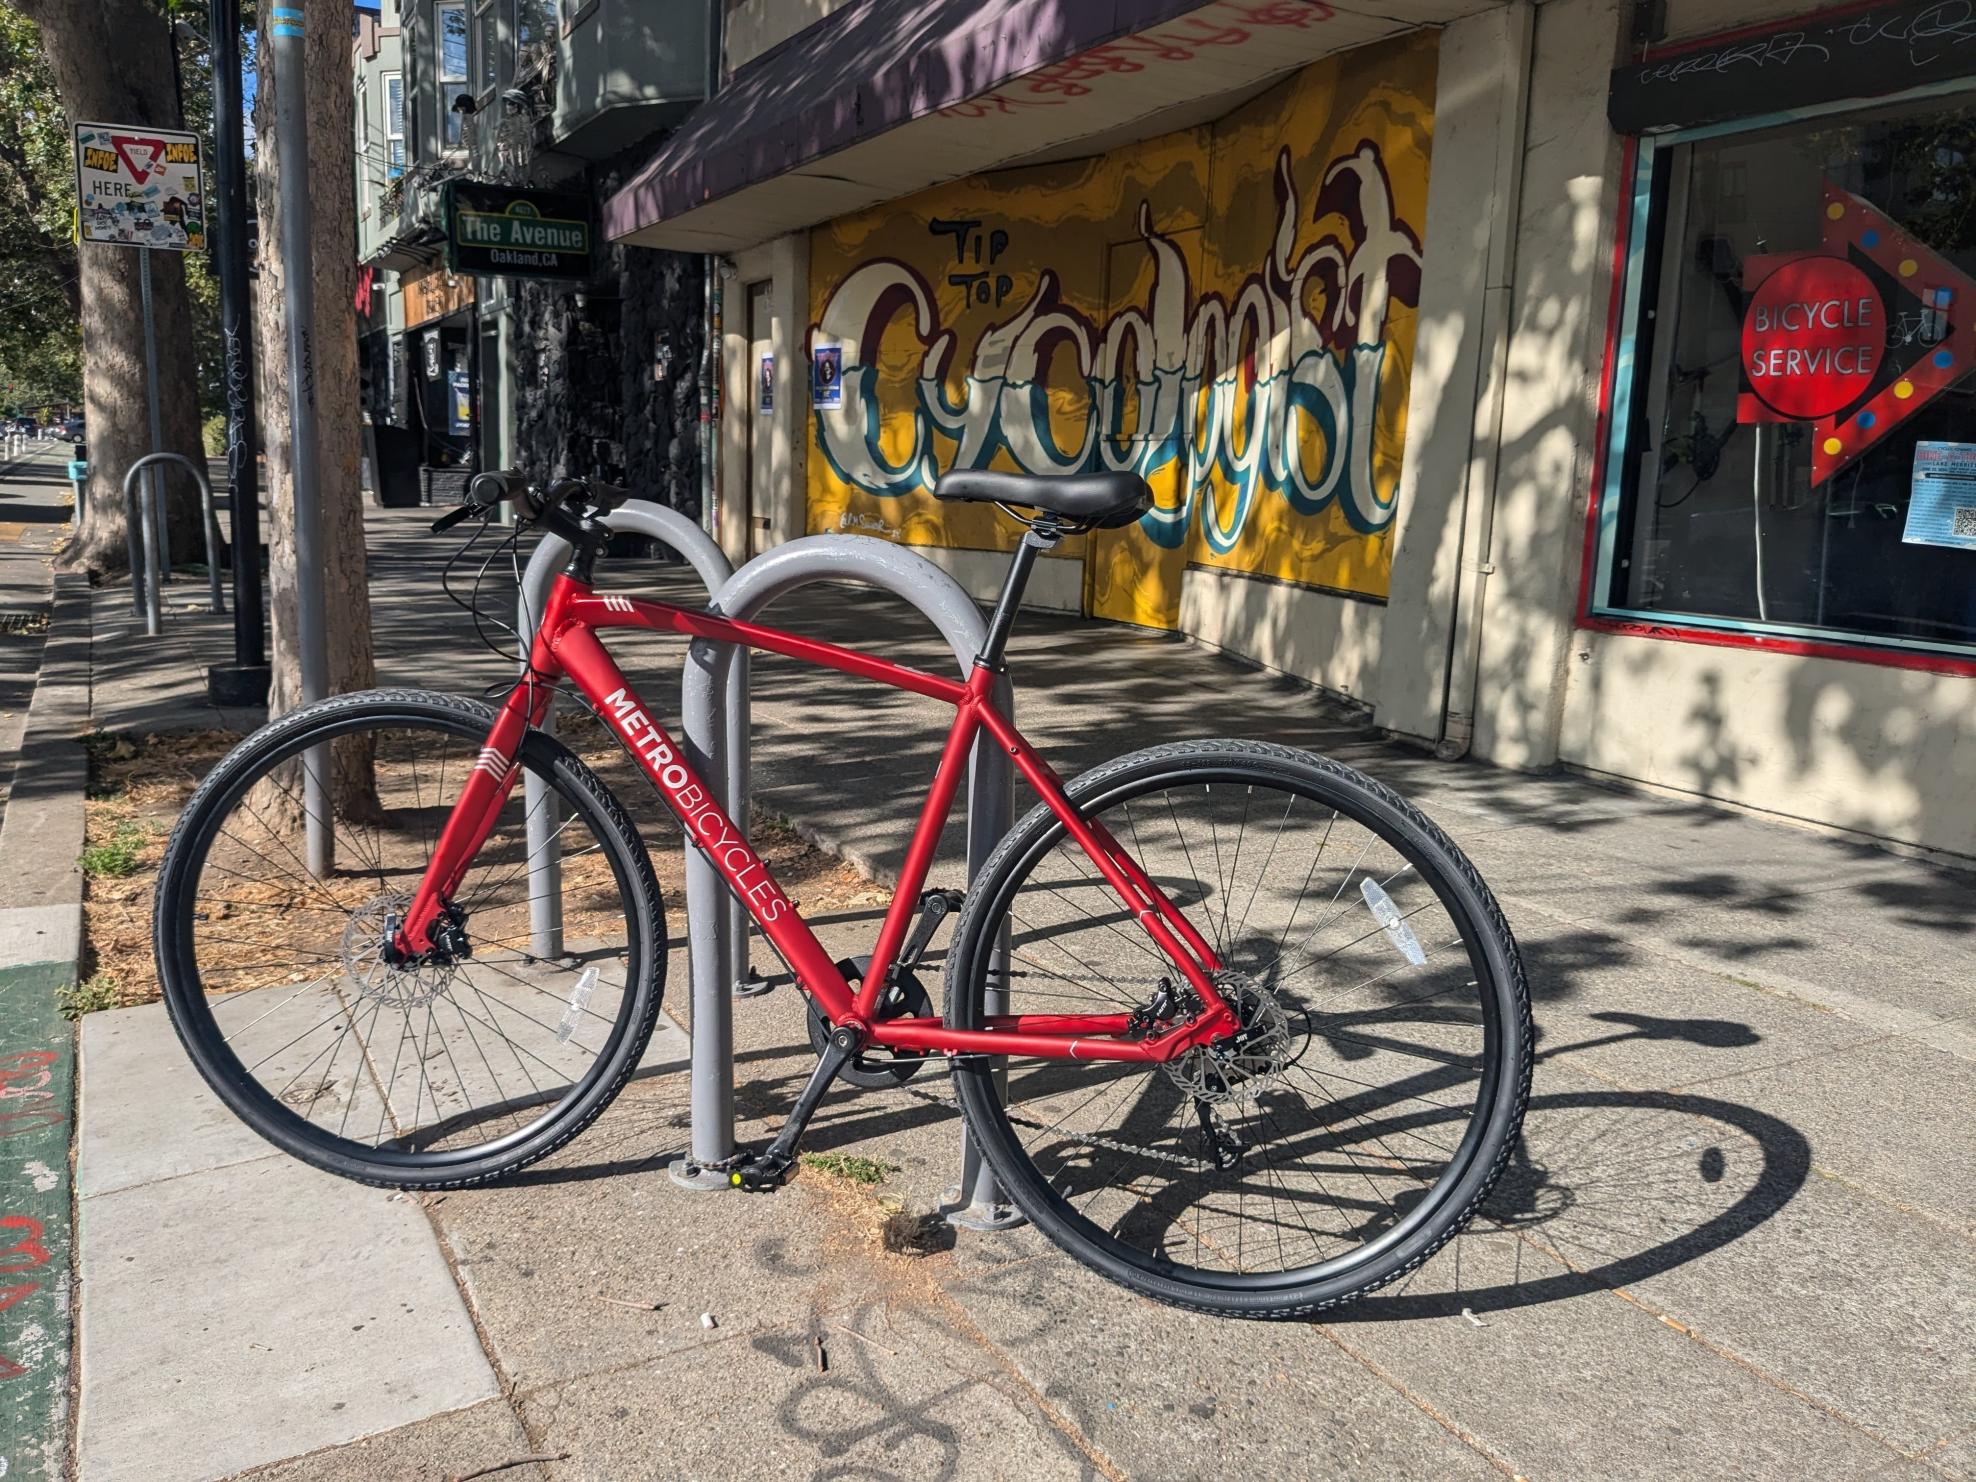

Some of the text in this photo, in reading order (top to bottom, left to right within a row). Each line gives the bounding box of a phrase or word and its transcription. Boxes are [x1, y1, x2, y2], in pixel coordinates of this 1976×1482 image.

[93, 180, 132, 198] HERE
[462, 216, 583, 248] The Avenue
[1755, 299, 1873, 333] BICYCLE
[1752, 347, 1873, 377] SERVICE
